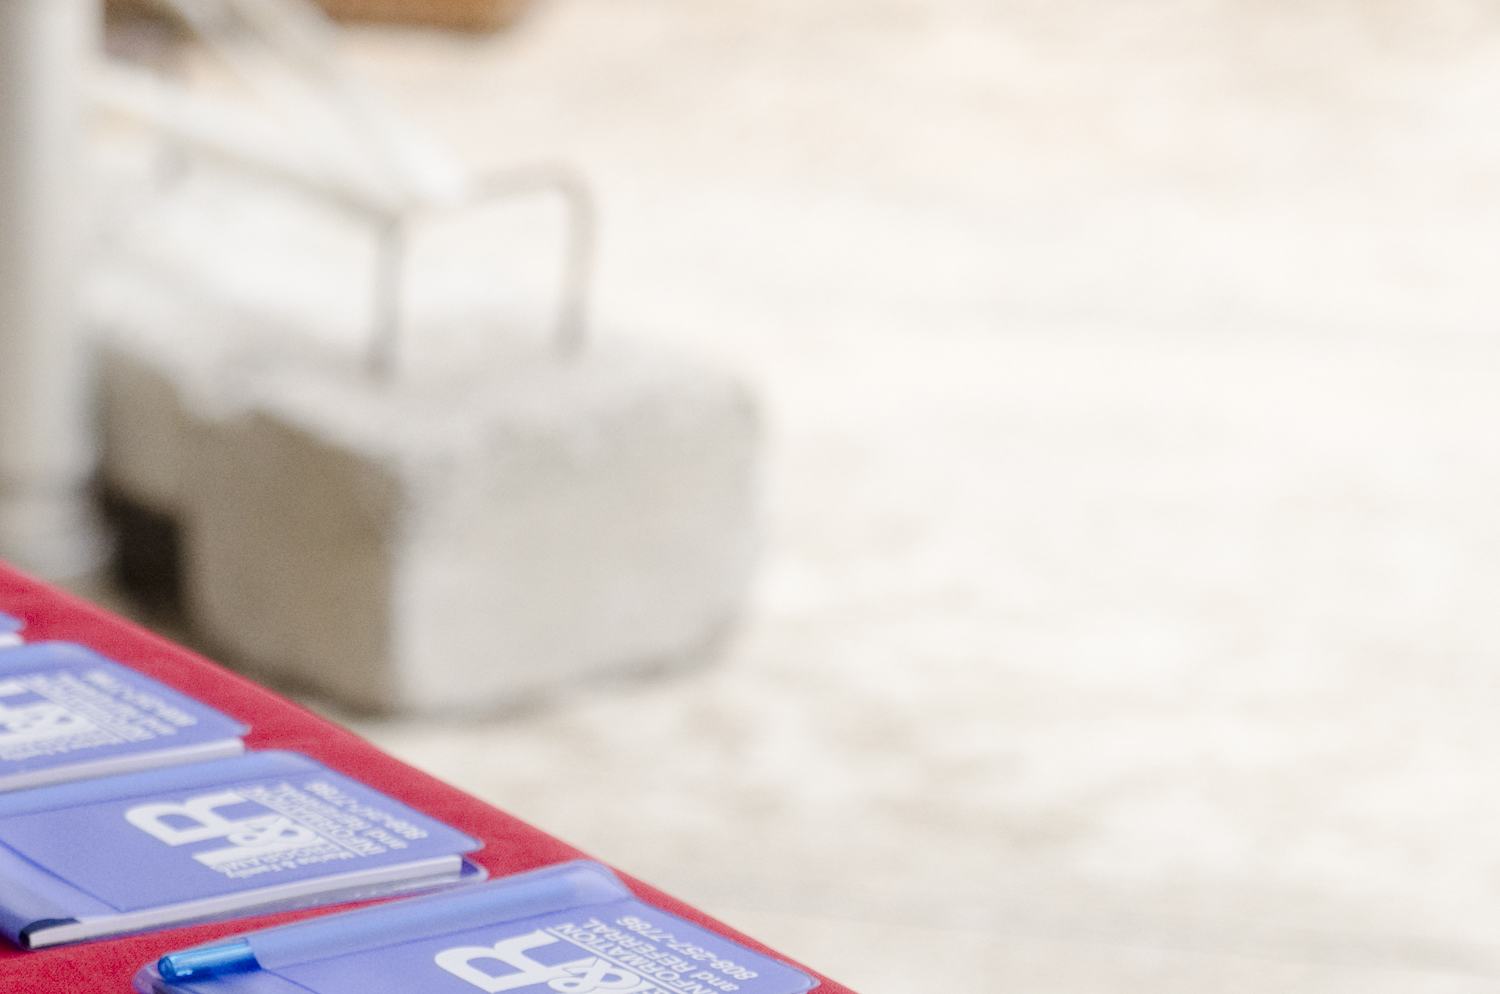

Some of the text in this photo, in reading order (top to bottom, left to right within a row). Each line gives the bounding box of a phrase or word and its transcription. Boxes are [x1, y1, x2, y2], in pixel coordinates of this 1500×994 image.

[125, 791, 325, 866] I&R
[583, 918, 739, 991] and REFERRAL
[616, 916, 758, 980] 808-257-7786
